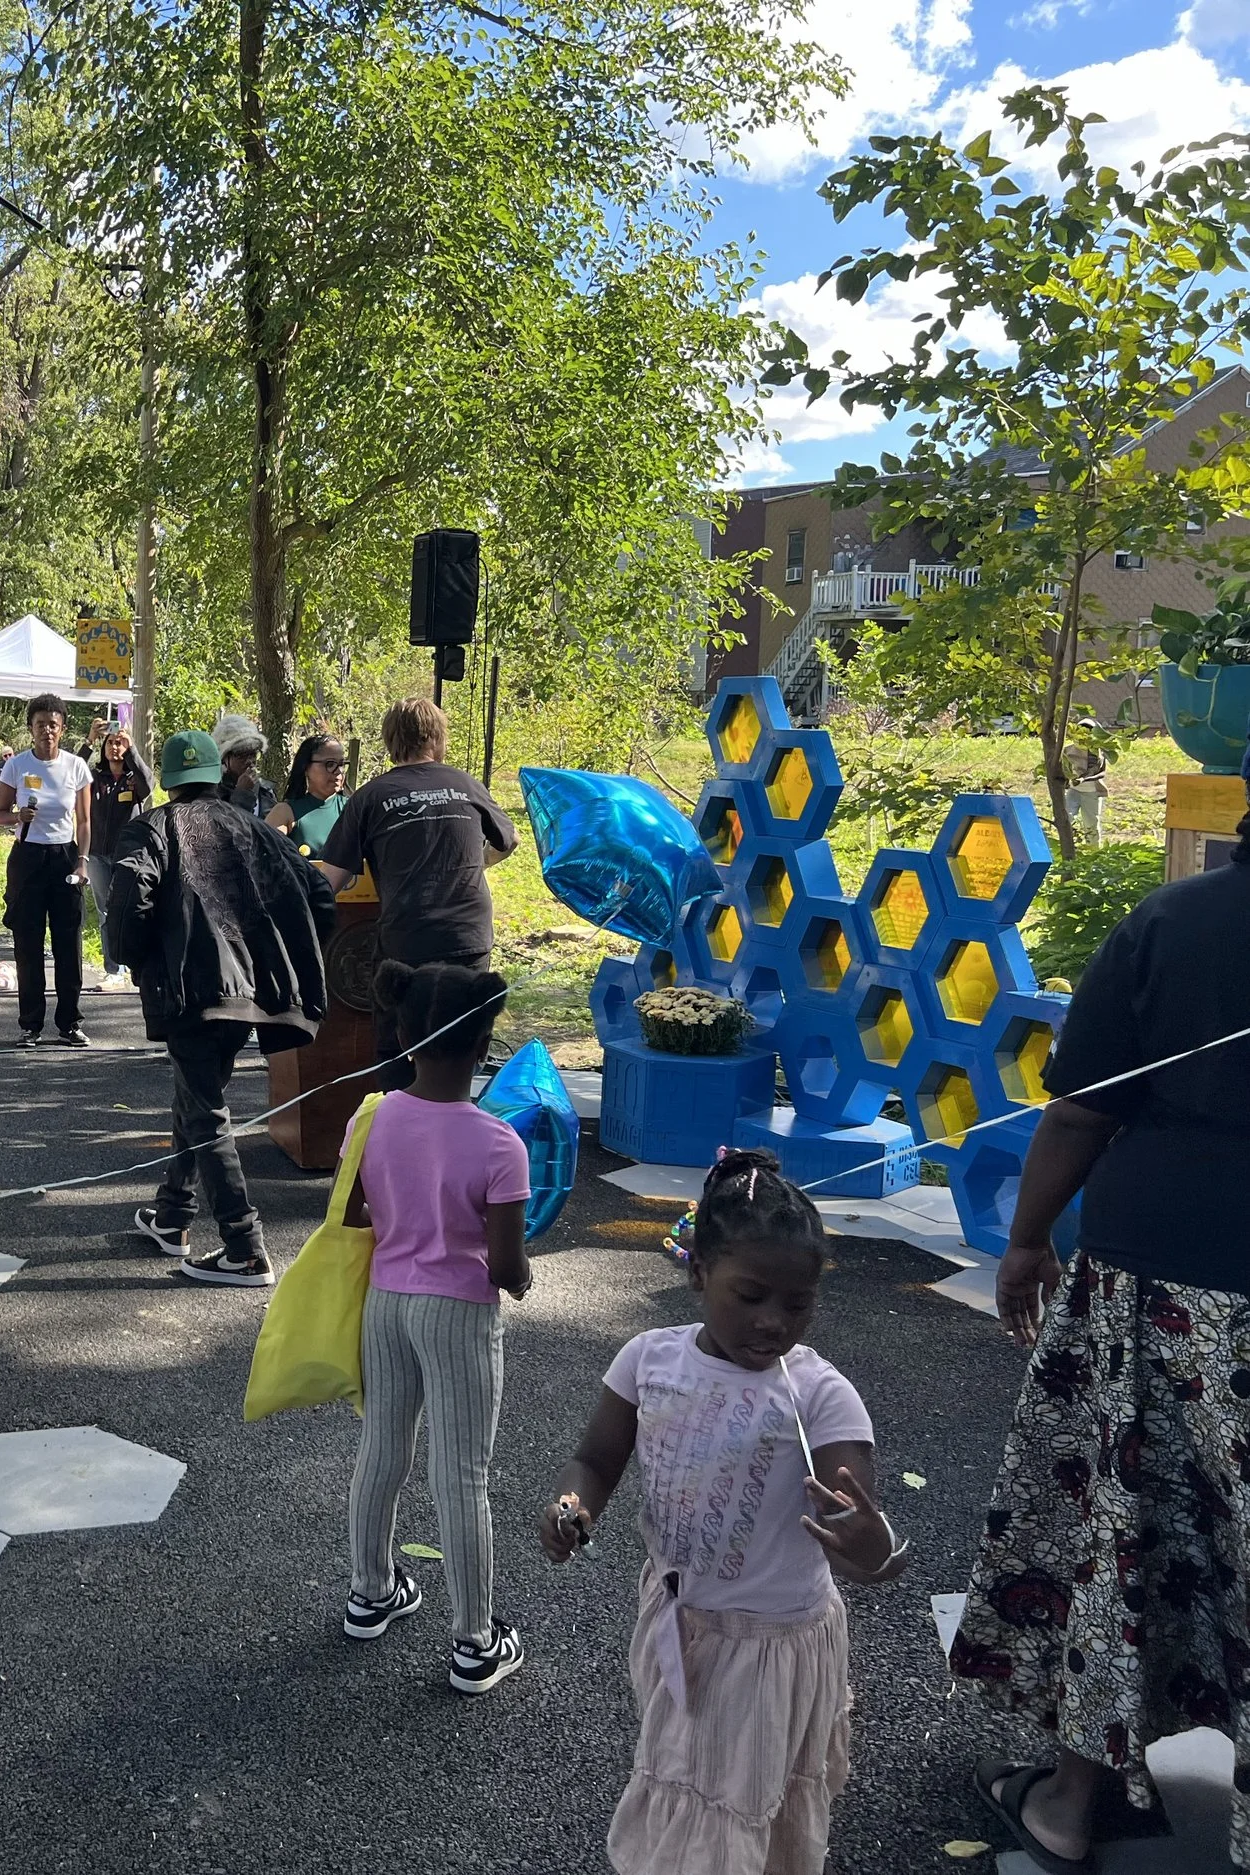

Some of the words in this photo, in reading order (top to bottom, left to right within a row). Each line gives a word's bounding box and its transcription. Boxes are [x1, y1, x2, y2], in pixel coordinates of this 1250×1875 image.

[81, 623, 126, 656] ALBANY
[80, 667, 116, 683] HIVE
[382, 796, 409, 812] Live
[604, 1054, 727, 1124] HOPE
[459, 1645, 475, 1655] NIKE
